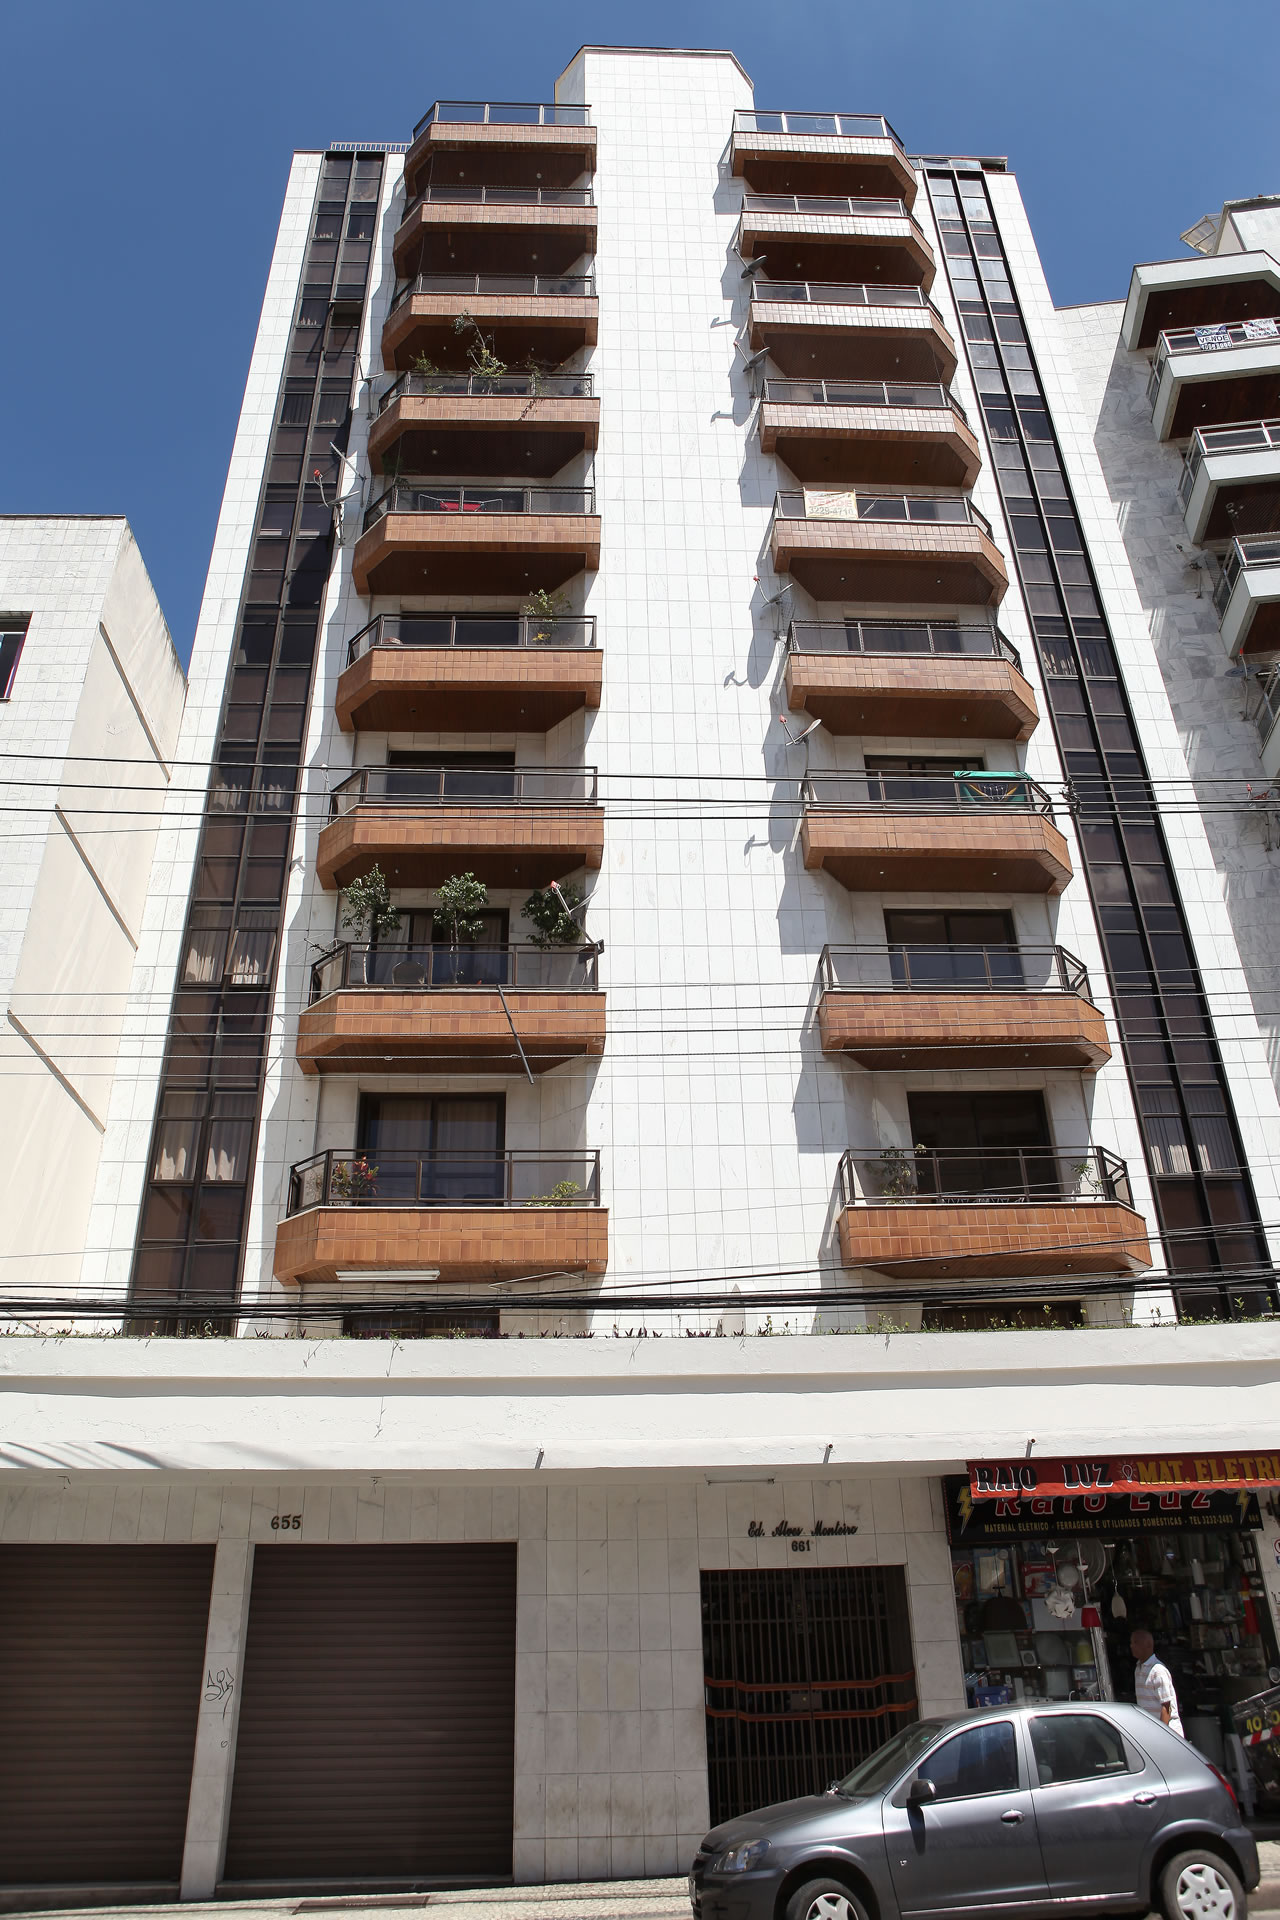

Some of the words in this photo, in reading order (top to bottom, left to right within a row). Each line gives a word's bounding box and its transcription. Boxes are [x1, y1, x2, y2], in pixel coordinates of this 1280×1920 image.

[975, 1466, 1037, 1491] RAIO
[1062, 1463, 1114, 1489] LUZ
[1136, 1460, 1191, 1485] MAT.
[271, 1514, 301, 1529] 655
[748, 1521, 765, 1537] Ed.
[772, 1520, 803, 1537] Alves
[811, 1520, 858, 1536] Monteiro
[984, 1522, 1016, 1533] MATERIAL
[1056, 1519, 1093, 1530] FERRAGENS
[791, 1540, 811, 1552] 661
